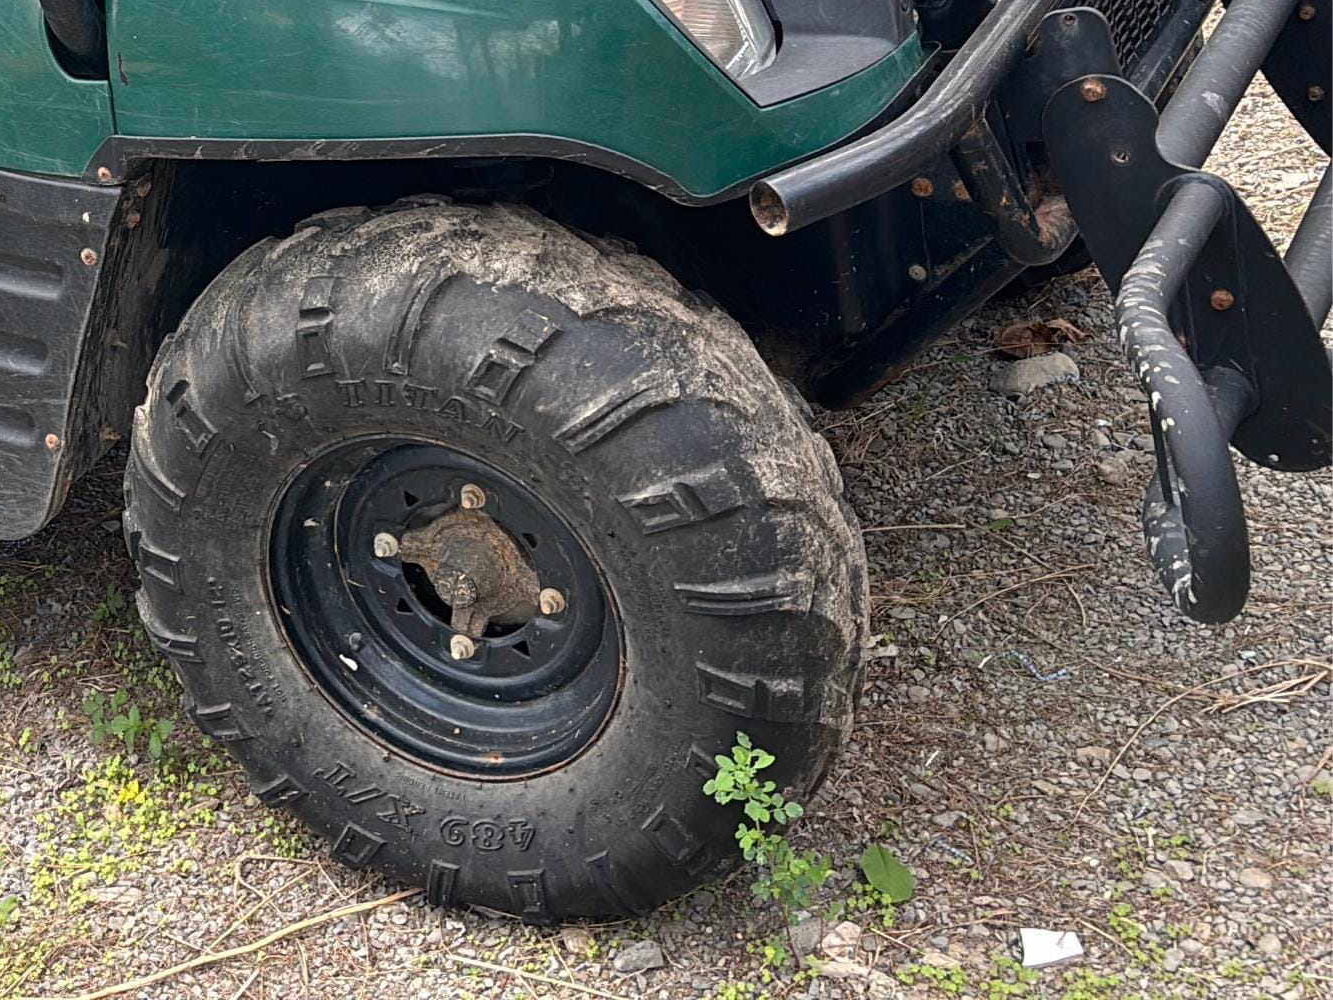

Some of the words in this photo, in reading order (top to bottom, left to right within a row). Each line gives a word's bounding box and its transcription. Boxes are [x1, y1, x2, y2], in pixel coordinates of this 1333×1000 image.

[335, 377, 526, 444] TITAN
[311, 759, 426, 833] X/T
[439, 816, 536, 853] 489
